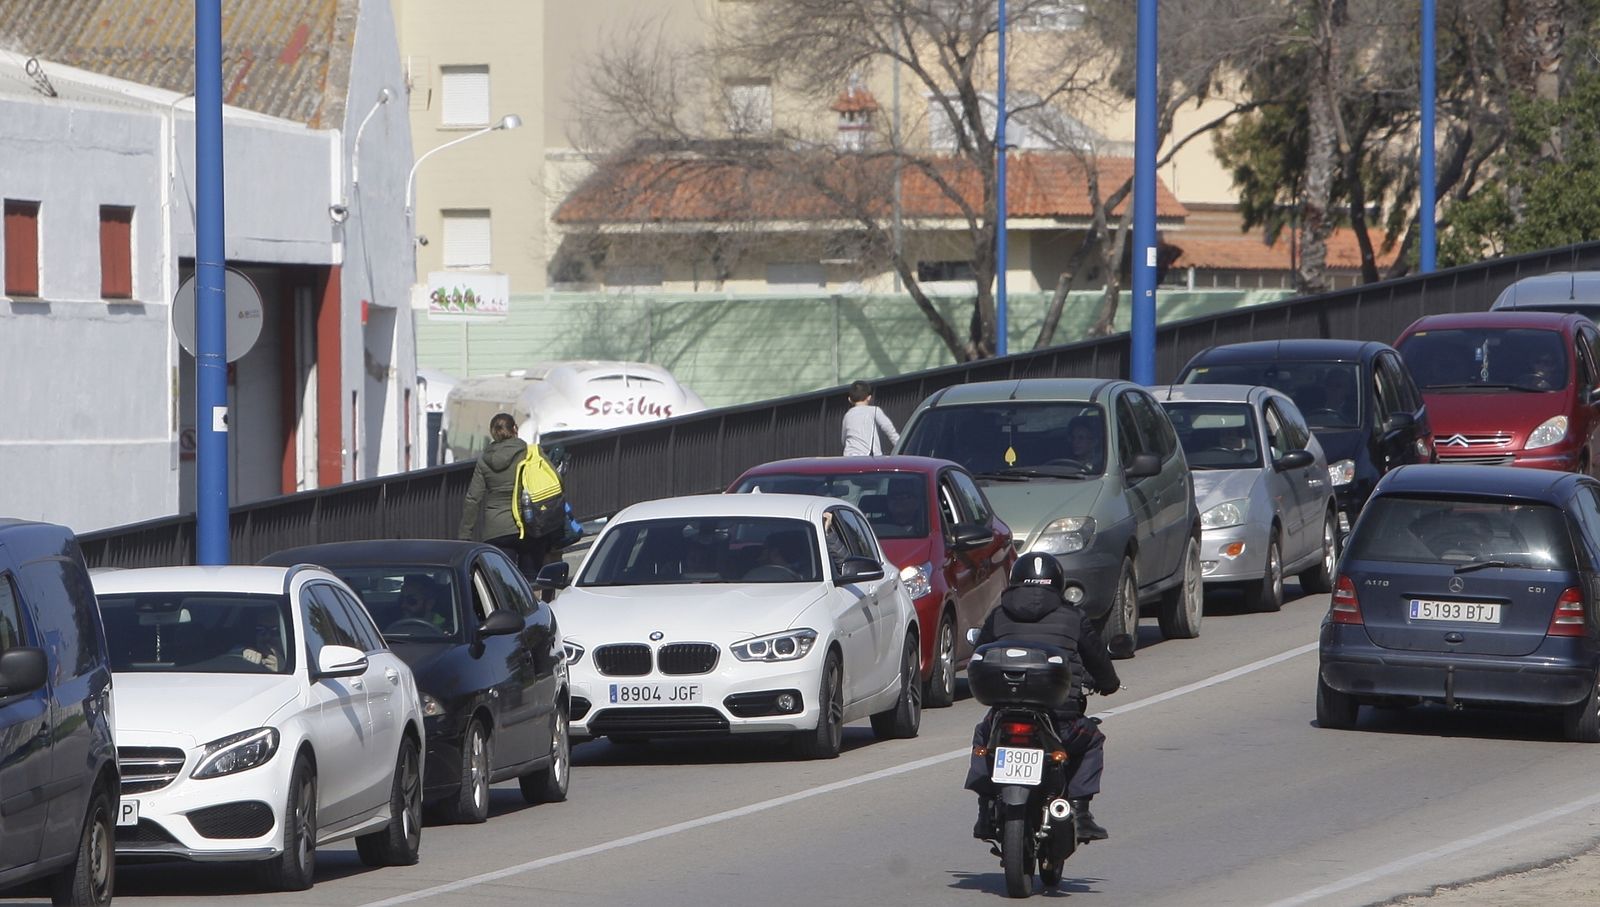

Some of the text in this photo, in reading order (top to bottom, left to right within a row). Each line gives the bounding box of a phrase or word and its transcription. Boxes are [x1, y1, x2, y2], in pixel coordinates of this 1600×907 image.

[584, 395, 673, 418] Socibus
[1423, 602, 1461, 619] 5193
[1466, 604, 1494, 621] BTJ
[621, 686, 661, 701] 8904
[668, 686, 698, 701] JGF
[1006, 750, 1039, 765] 3900
[1005, 765, 1032, 778] JKD
